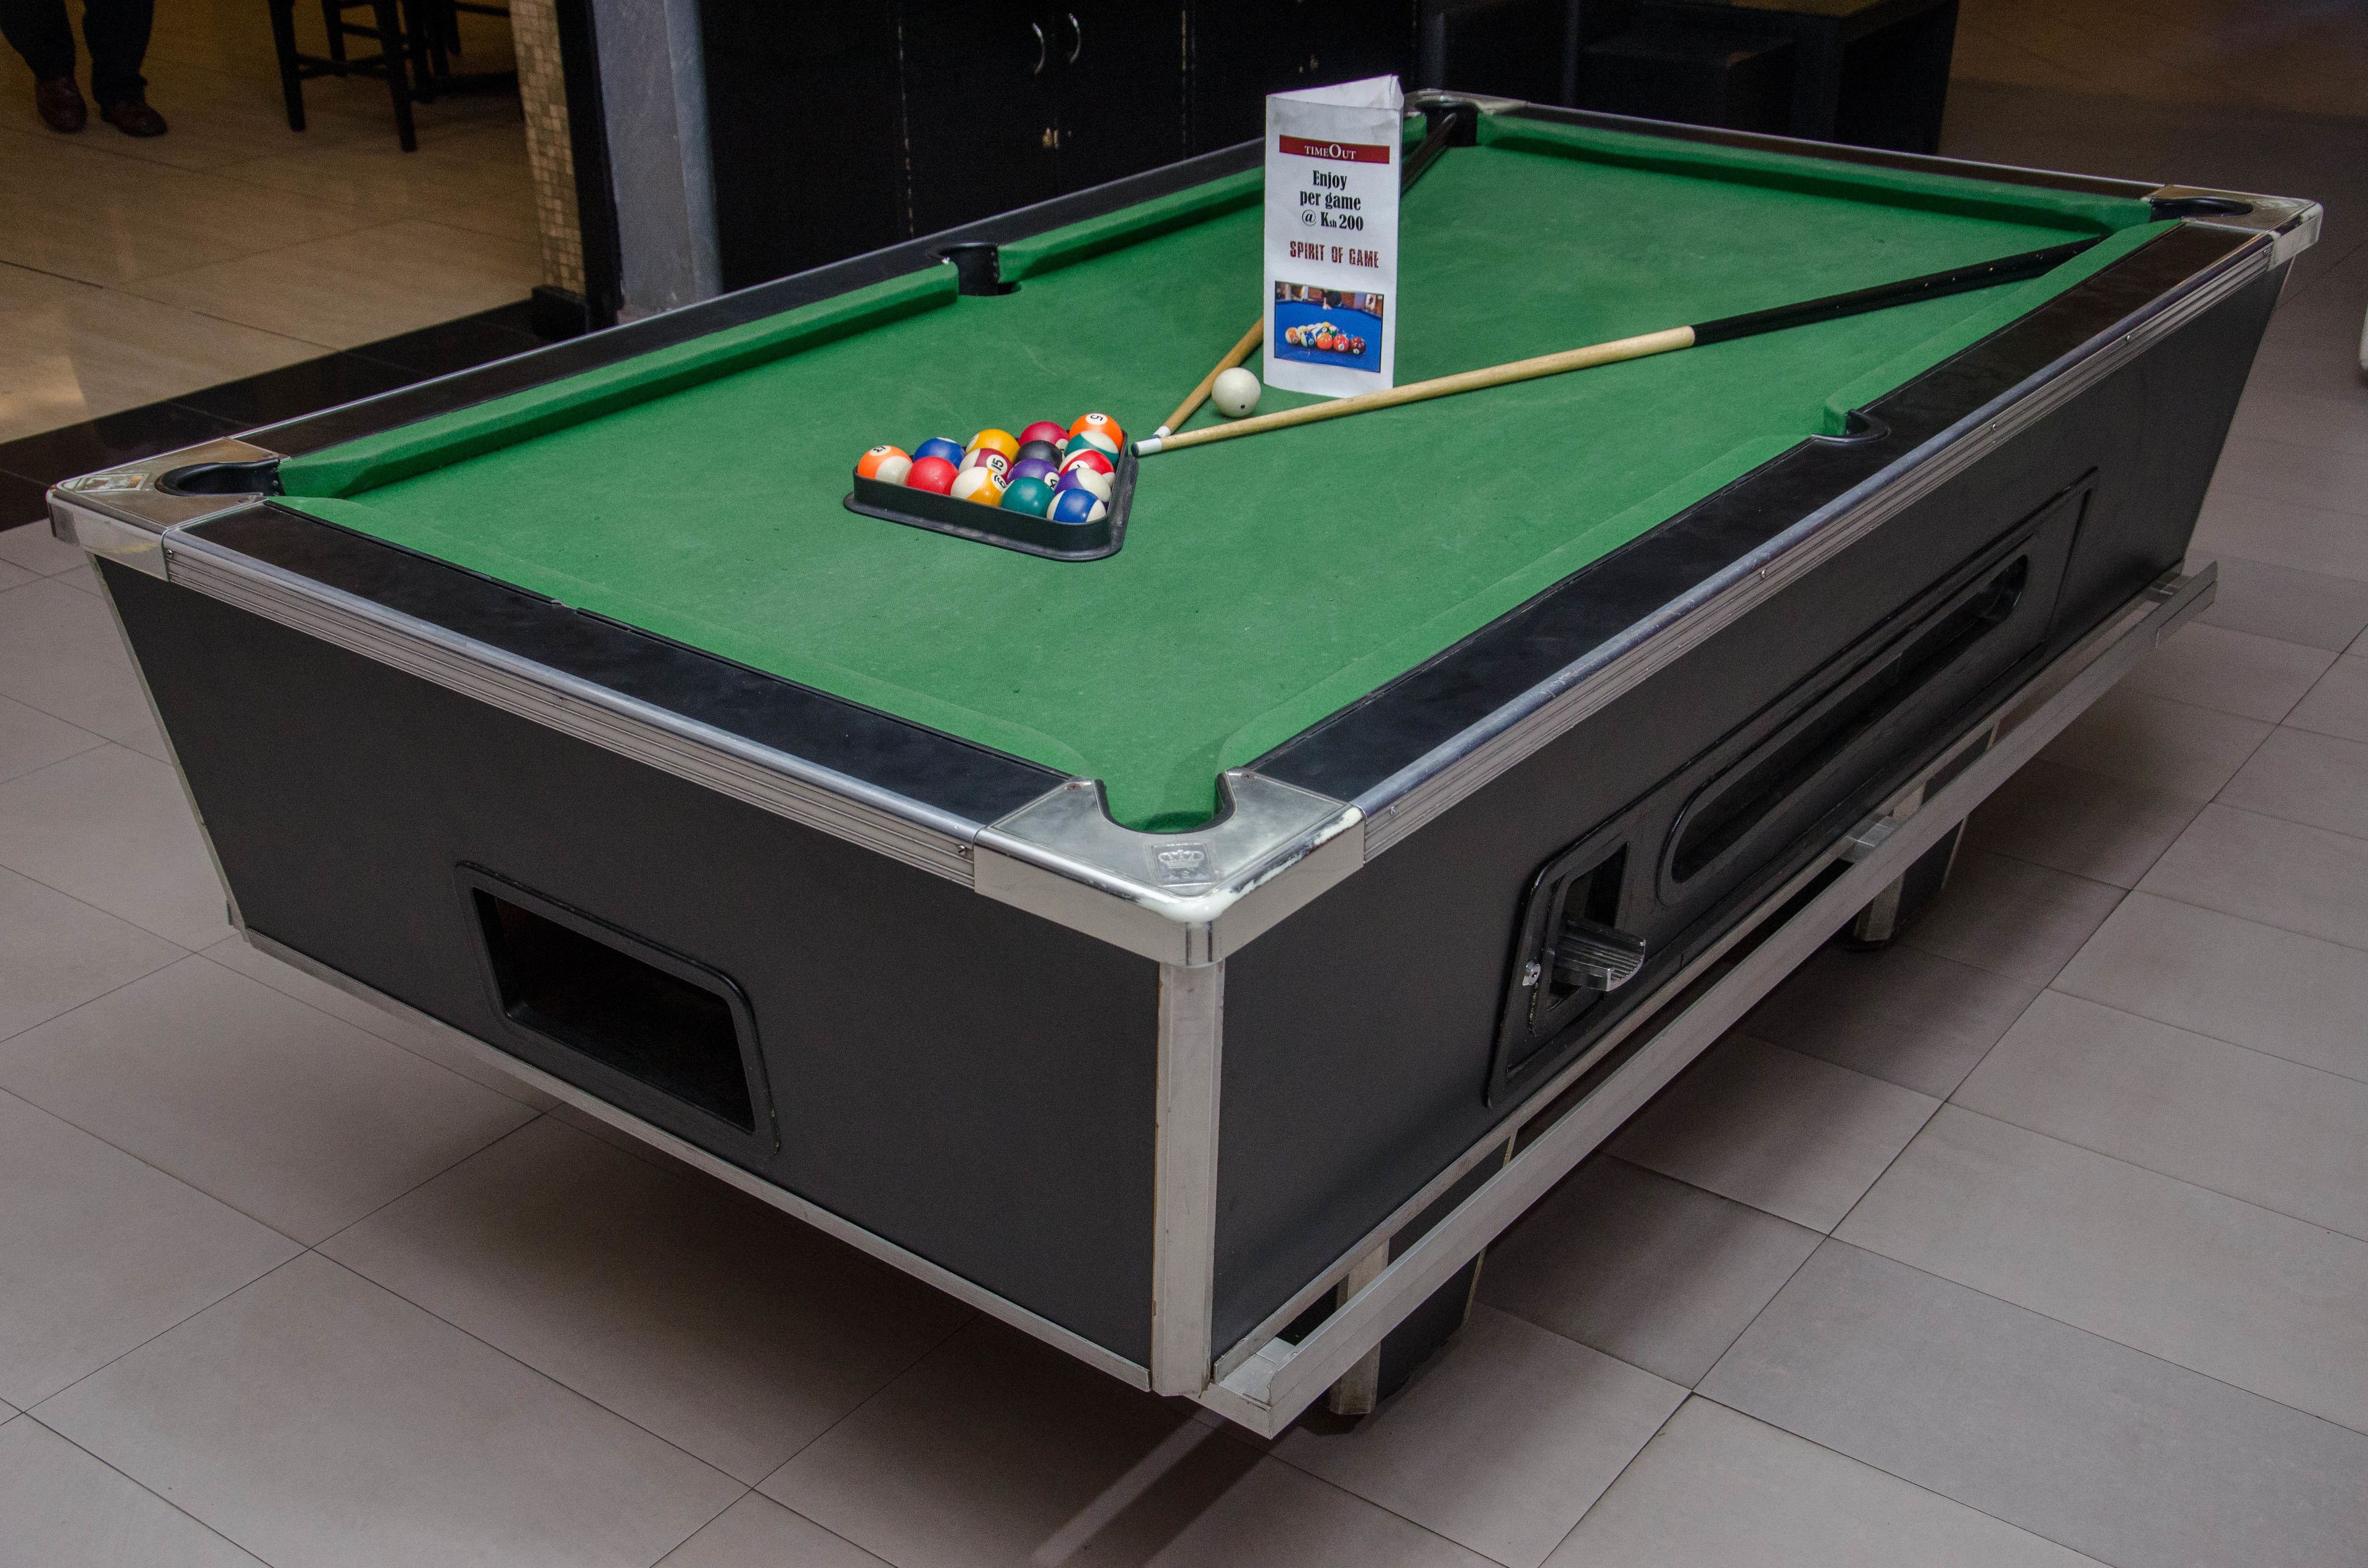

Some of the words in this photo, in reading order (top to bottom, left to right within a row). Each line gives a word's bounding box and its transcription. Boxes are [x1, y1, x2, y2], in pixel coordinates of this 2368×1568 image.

[1313, 170, 1347, 191] Enjoy
[1300, 191, 1321, 206] per
[1325, 193, 1361, 210] game
[1302, 210, 1317, 226] @
[1339, 214, 1363, 231] 200
[1290, 240, 1325, 261] SPIRIT
[1331, 246, 1343, 263] OF
[1349, 249, 1379, 268] GAME
[991, 458, 1004, 471] 15
[1050, 478, 1058, 488] 4
